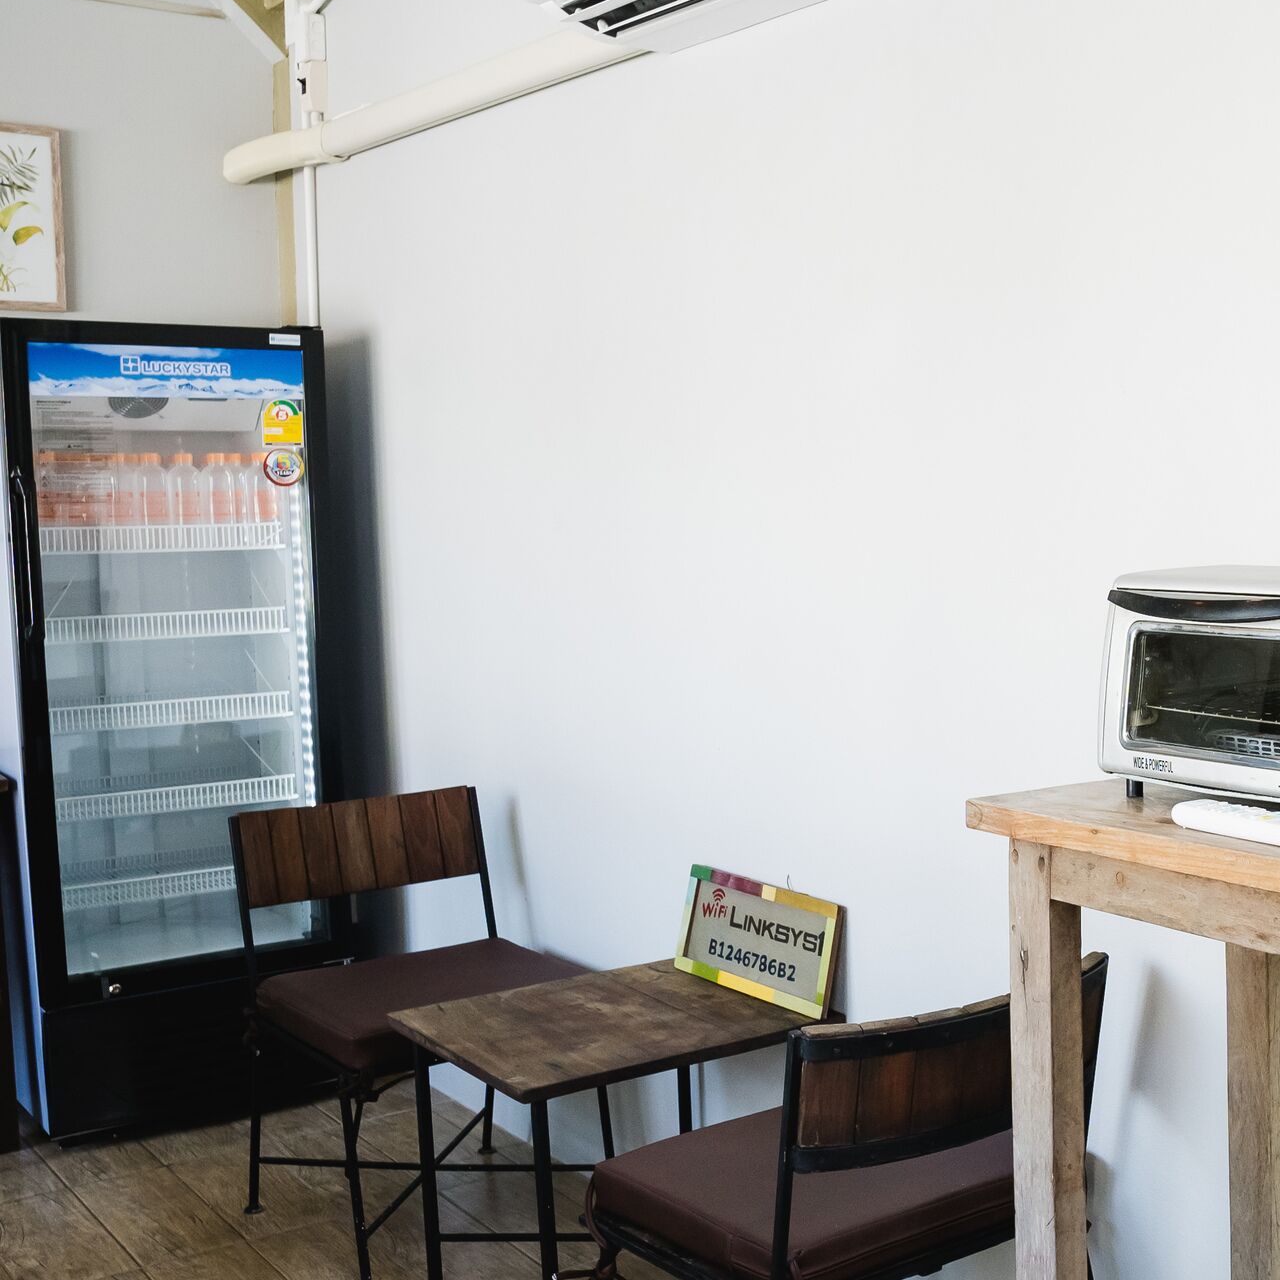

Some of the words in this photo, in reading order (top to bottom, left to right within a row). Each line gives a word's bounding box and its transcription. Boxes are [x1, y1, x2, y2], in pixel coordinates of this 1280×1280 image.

[143, 361, 230, 376] LUCKYSTAR
[1133, 756, 1144, 769] WIDE
[1149, 758, 1174, 773] POWERFUL
[702, 901, 729, 919] WiFi
